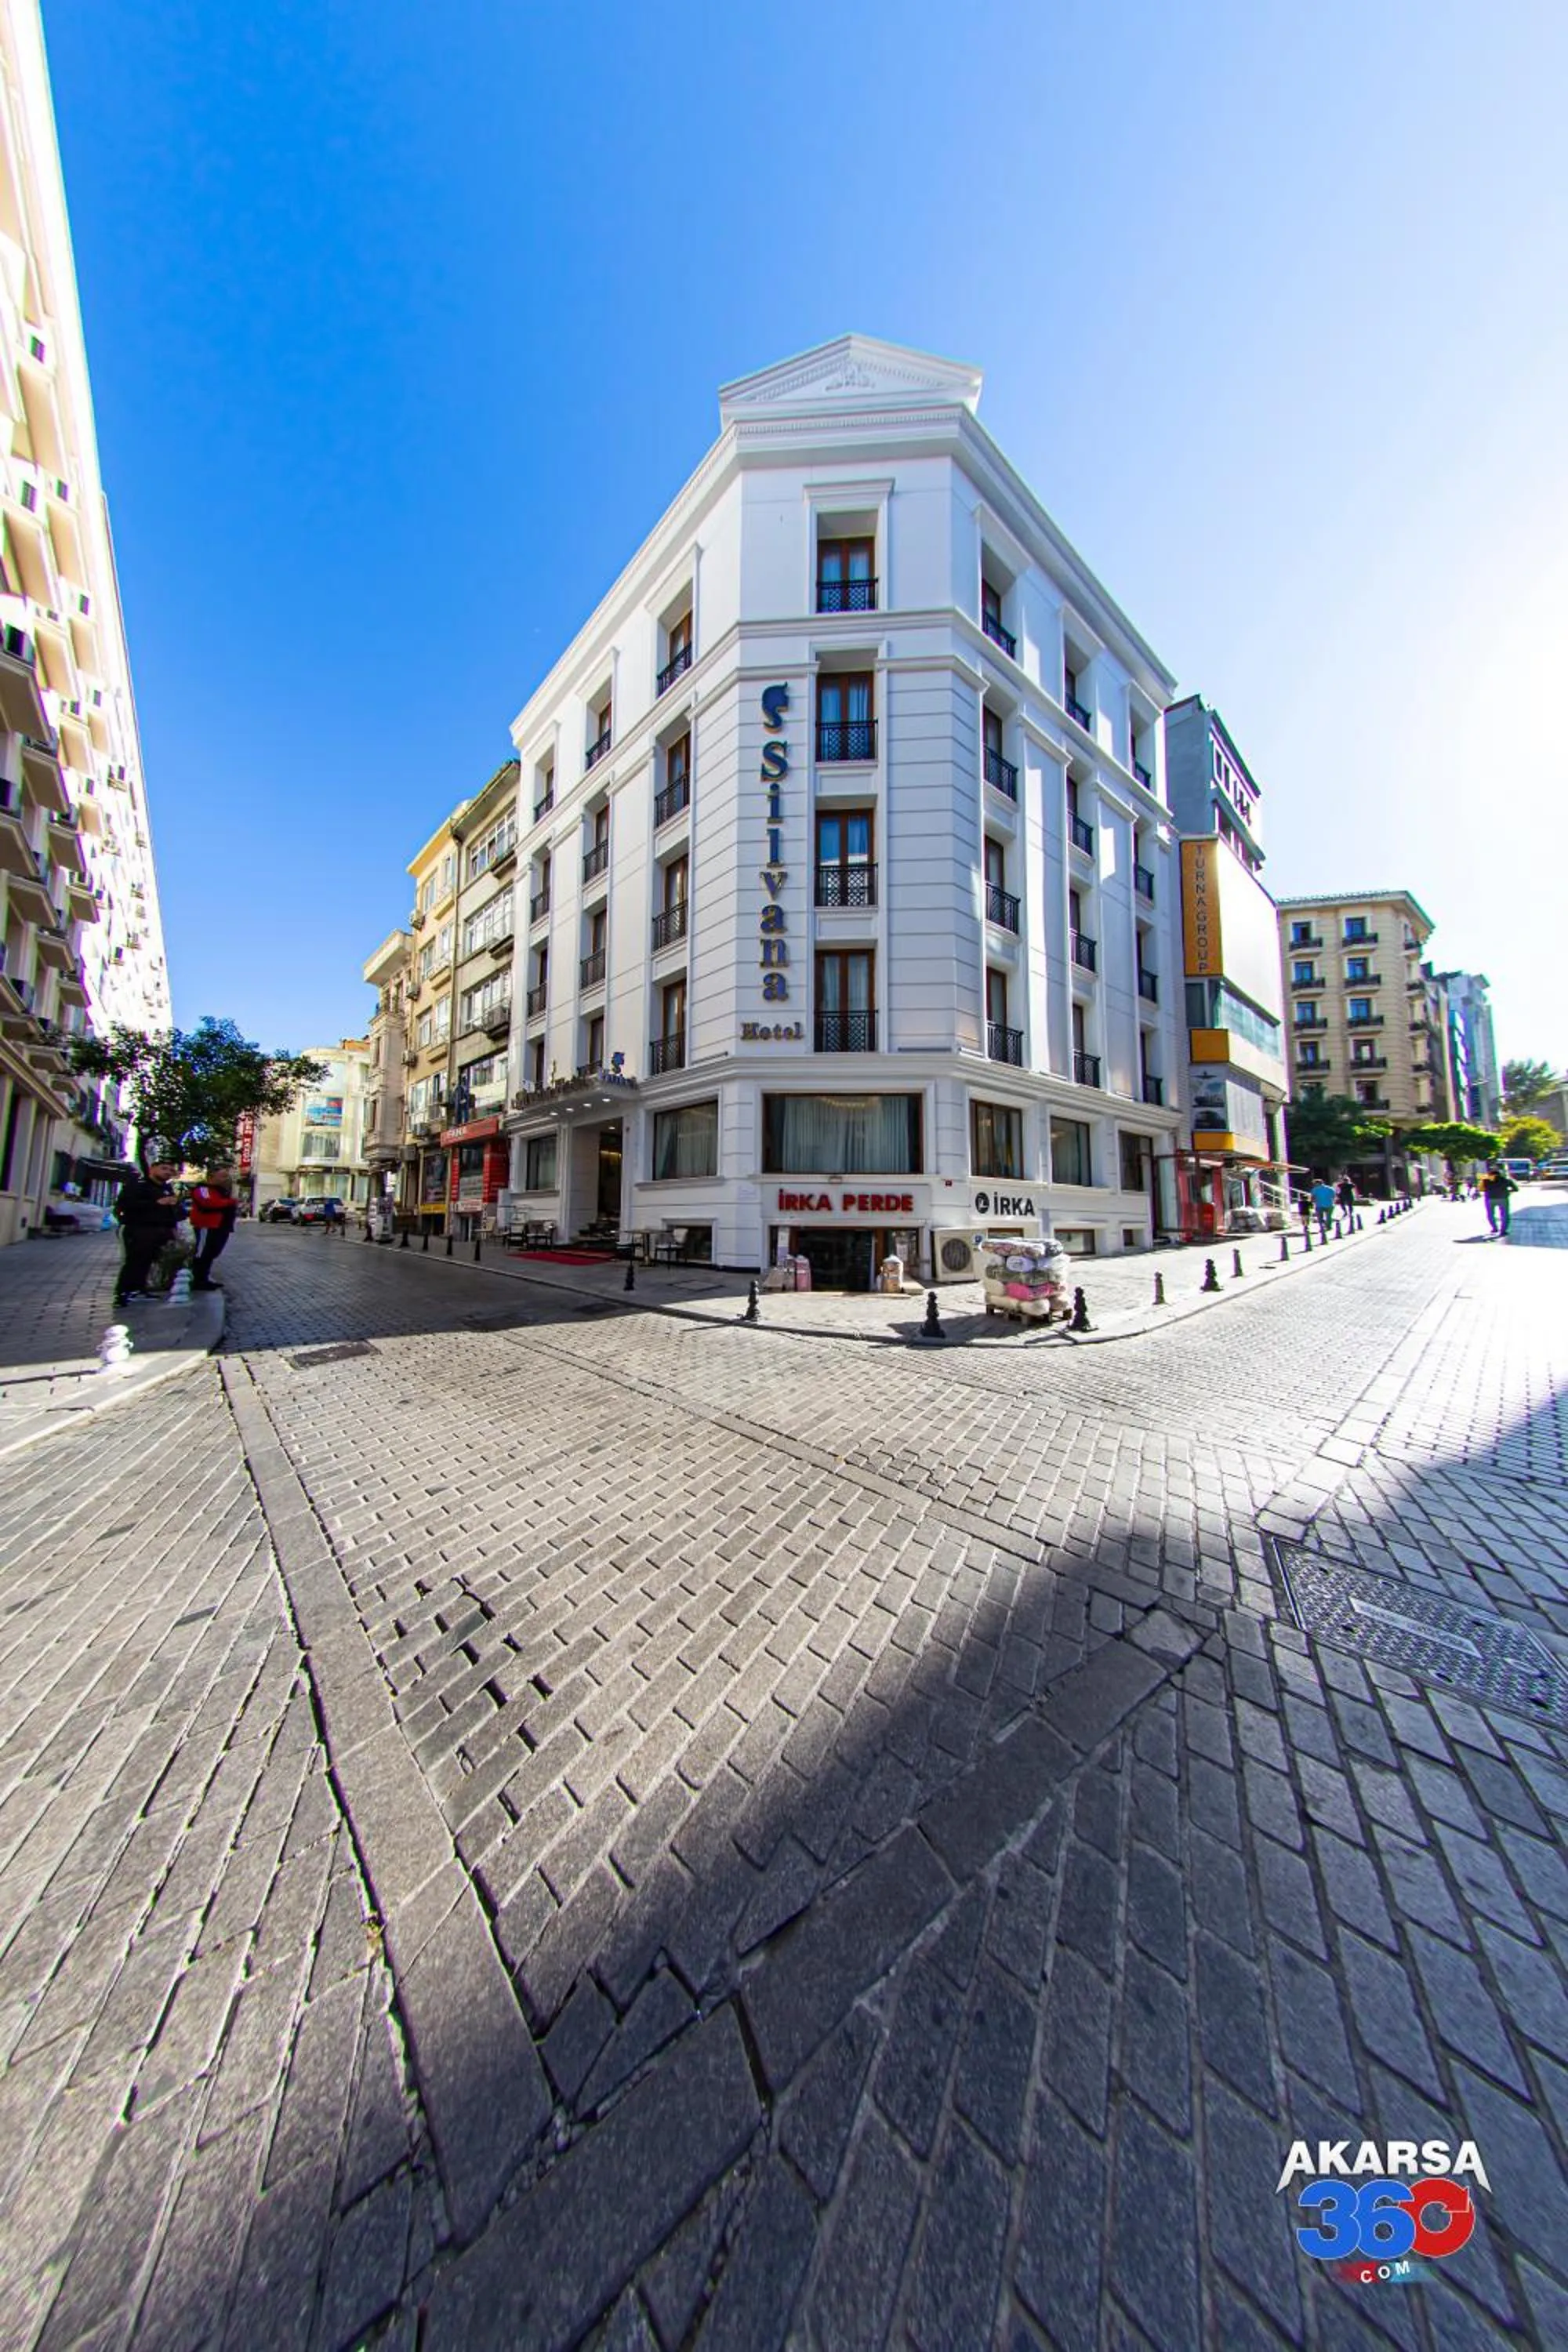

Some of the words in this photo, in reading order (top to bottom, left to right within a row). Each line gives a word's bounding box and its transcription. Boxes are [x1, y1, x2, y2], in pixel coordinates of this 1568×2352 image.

[760, 740, 789, 1002] Silvana
[1195, 844, 1208, 973] TURNAGROUP
[741, 1022, 804, 1041] Hotel
[779, 1189, 832, 1211] İRKA
[843, 1193, 913, 1211] PERDE
[993, 1191, 1035, 1216] İRKA
